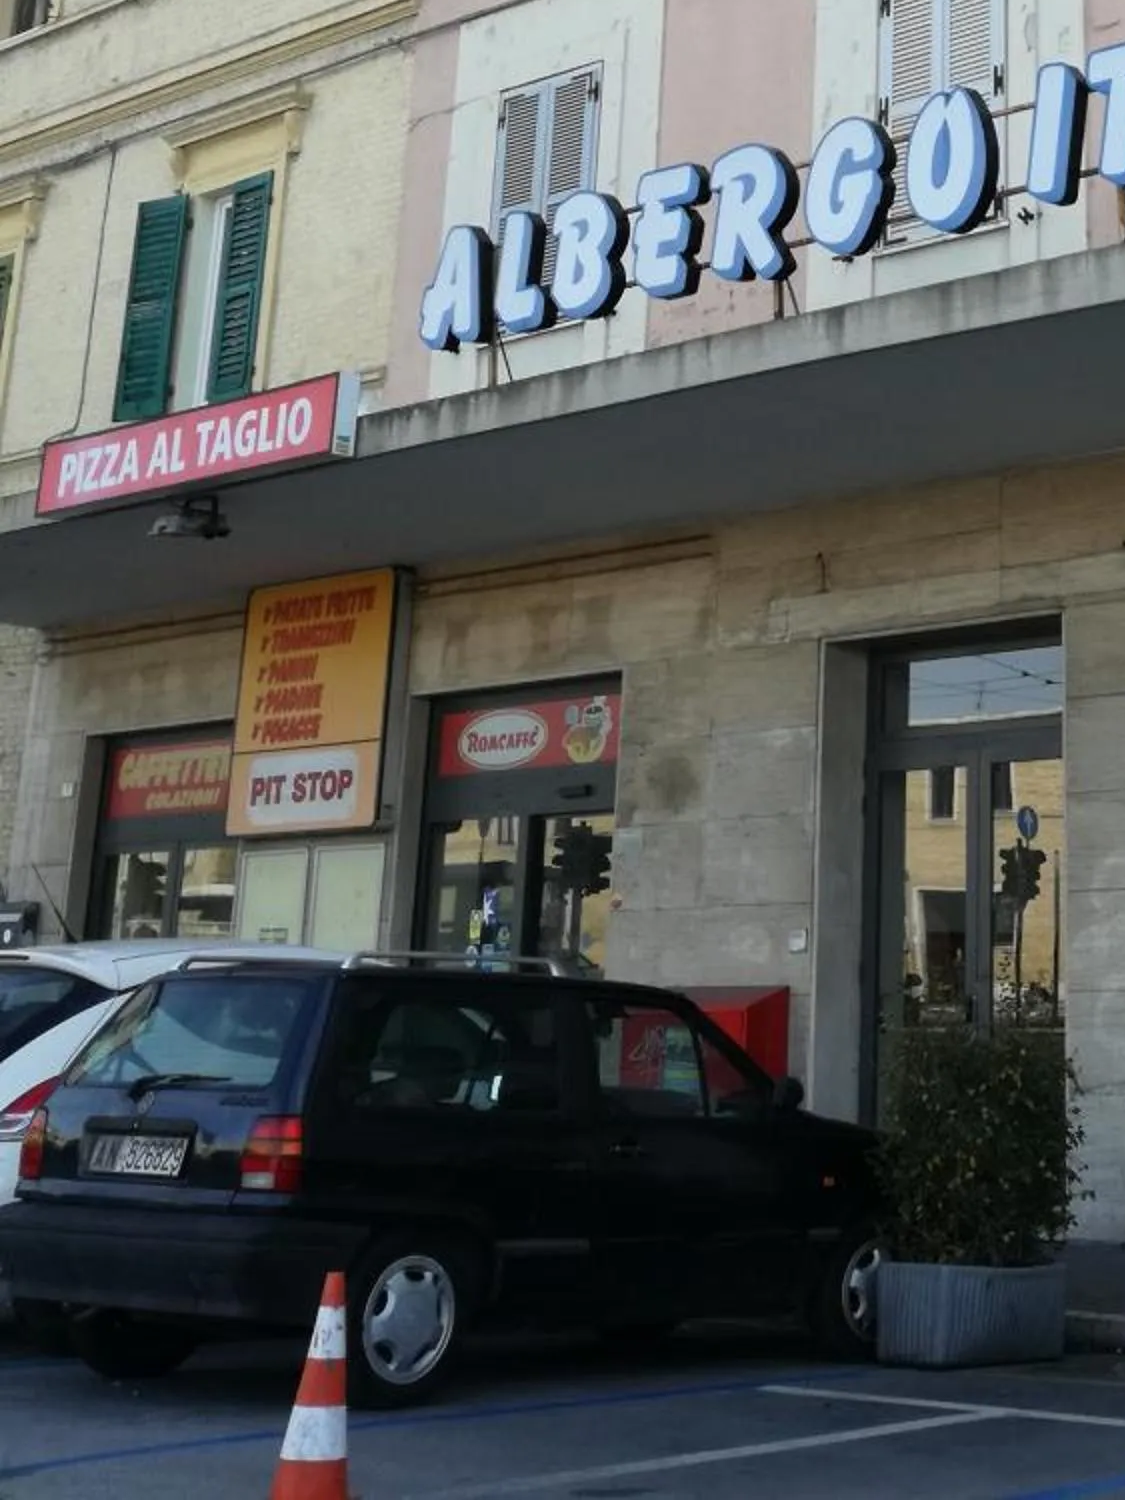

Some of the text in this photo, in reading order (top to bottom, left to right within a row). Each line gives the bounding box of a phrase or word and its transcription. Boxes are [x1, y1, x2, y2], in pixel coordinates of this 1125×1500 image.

[419, 86, 998, 352] ALBERGO
[57, 397, 313, 498] PIZZA AL TAGLIO
[250, 769, 353, 807] PIT STOP
